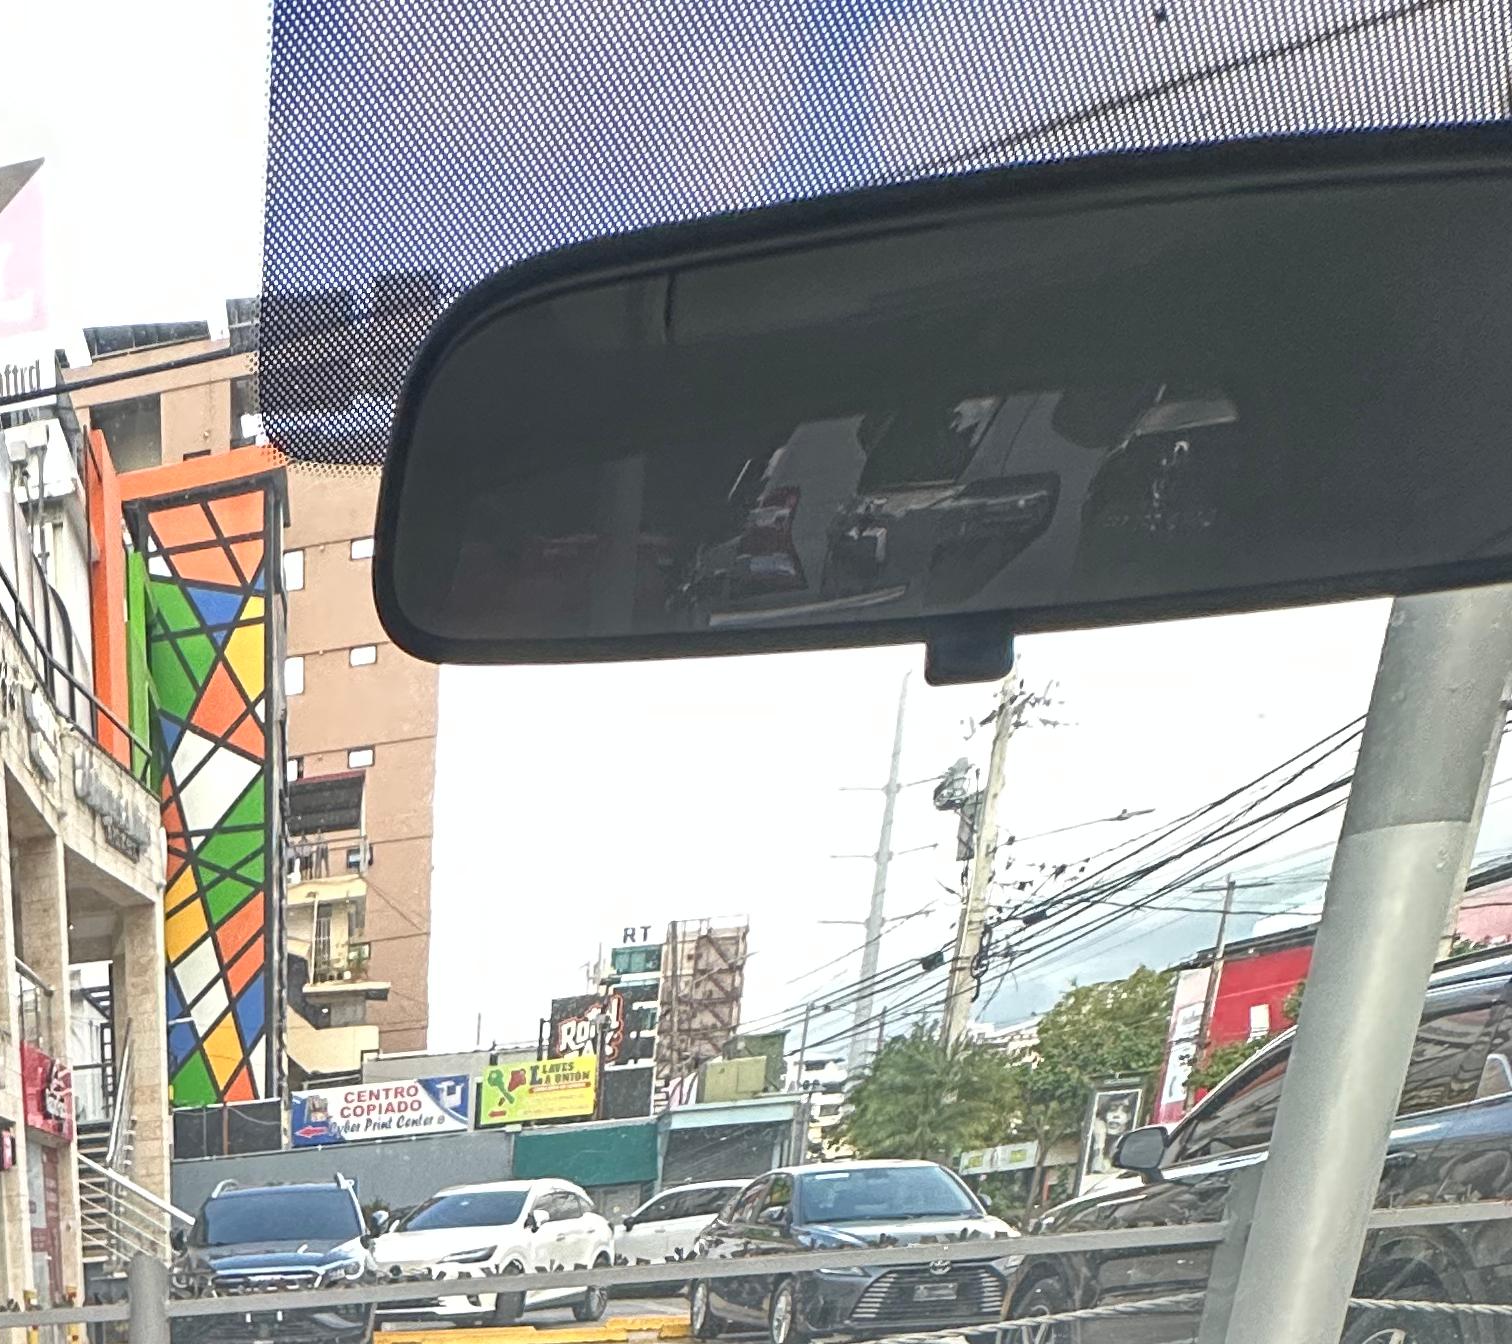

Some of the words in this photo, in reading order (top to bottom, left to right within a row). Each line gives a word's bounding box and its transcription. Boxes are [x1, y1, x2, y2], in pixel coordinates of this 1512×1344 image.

[344, 1085, 419, 1104] CENTRO
[340, 1099, 423, 1119] COPIADO
[364, 1116, 393, 1131] Print
[396, 1113, 433, 1129] Center
